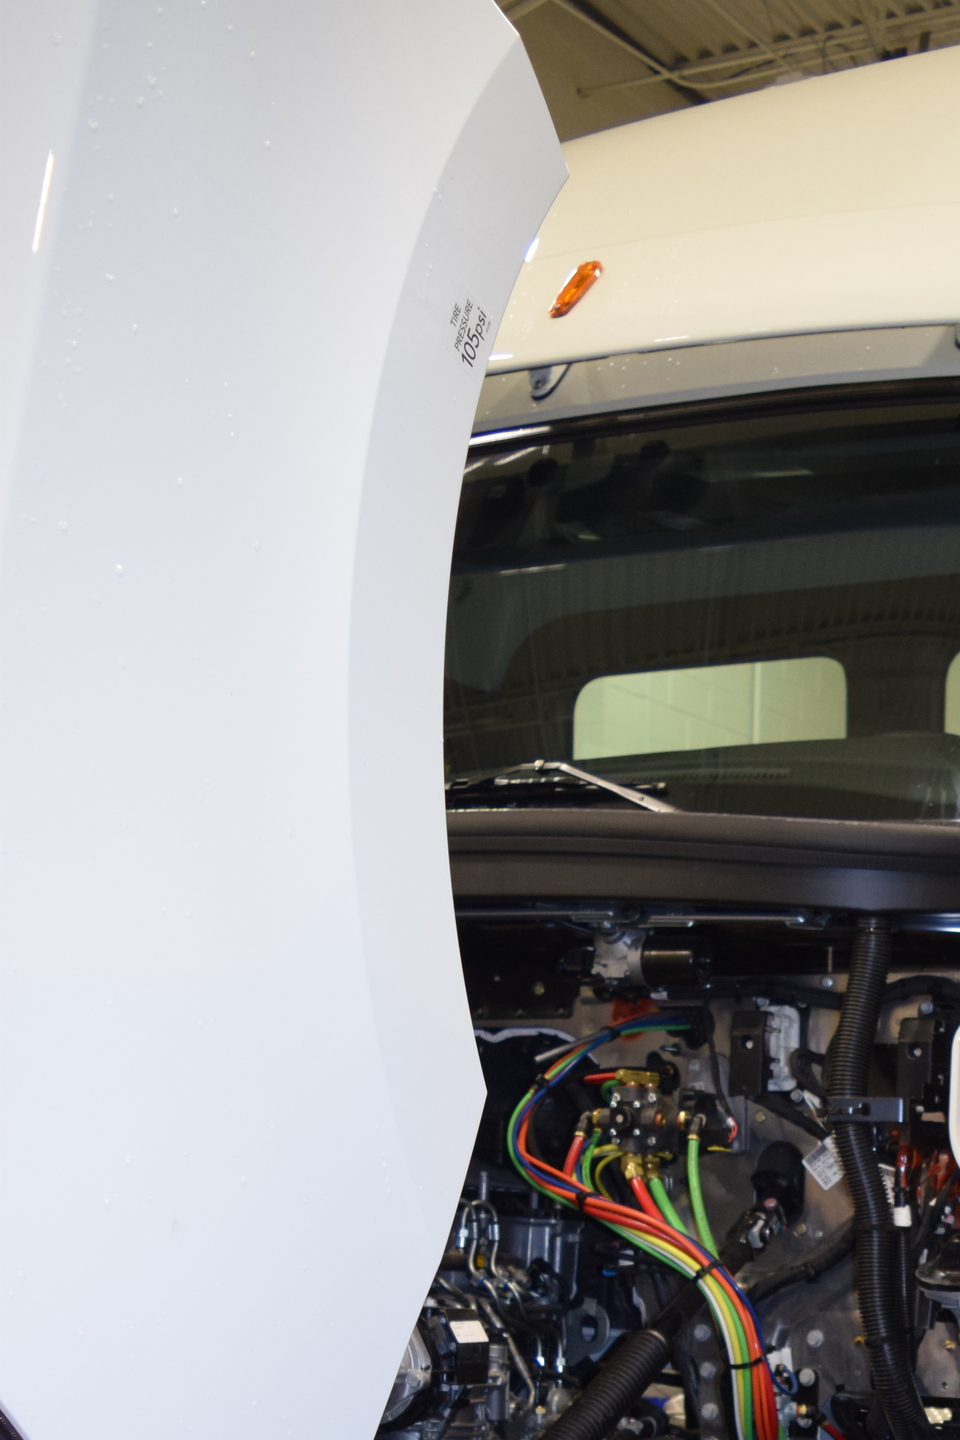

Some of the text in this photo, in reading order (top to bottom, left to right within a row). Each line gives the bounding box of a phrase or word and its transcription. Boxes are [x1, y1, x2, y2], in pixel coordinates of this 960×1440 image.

[449, 303, 462, 327] TIRE
[454, 299, 474, 352] PRESSURE
[461, 307, 487, 368] 105psi
